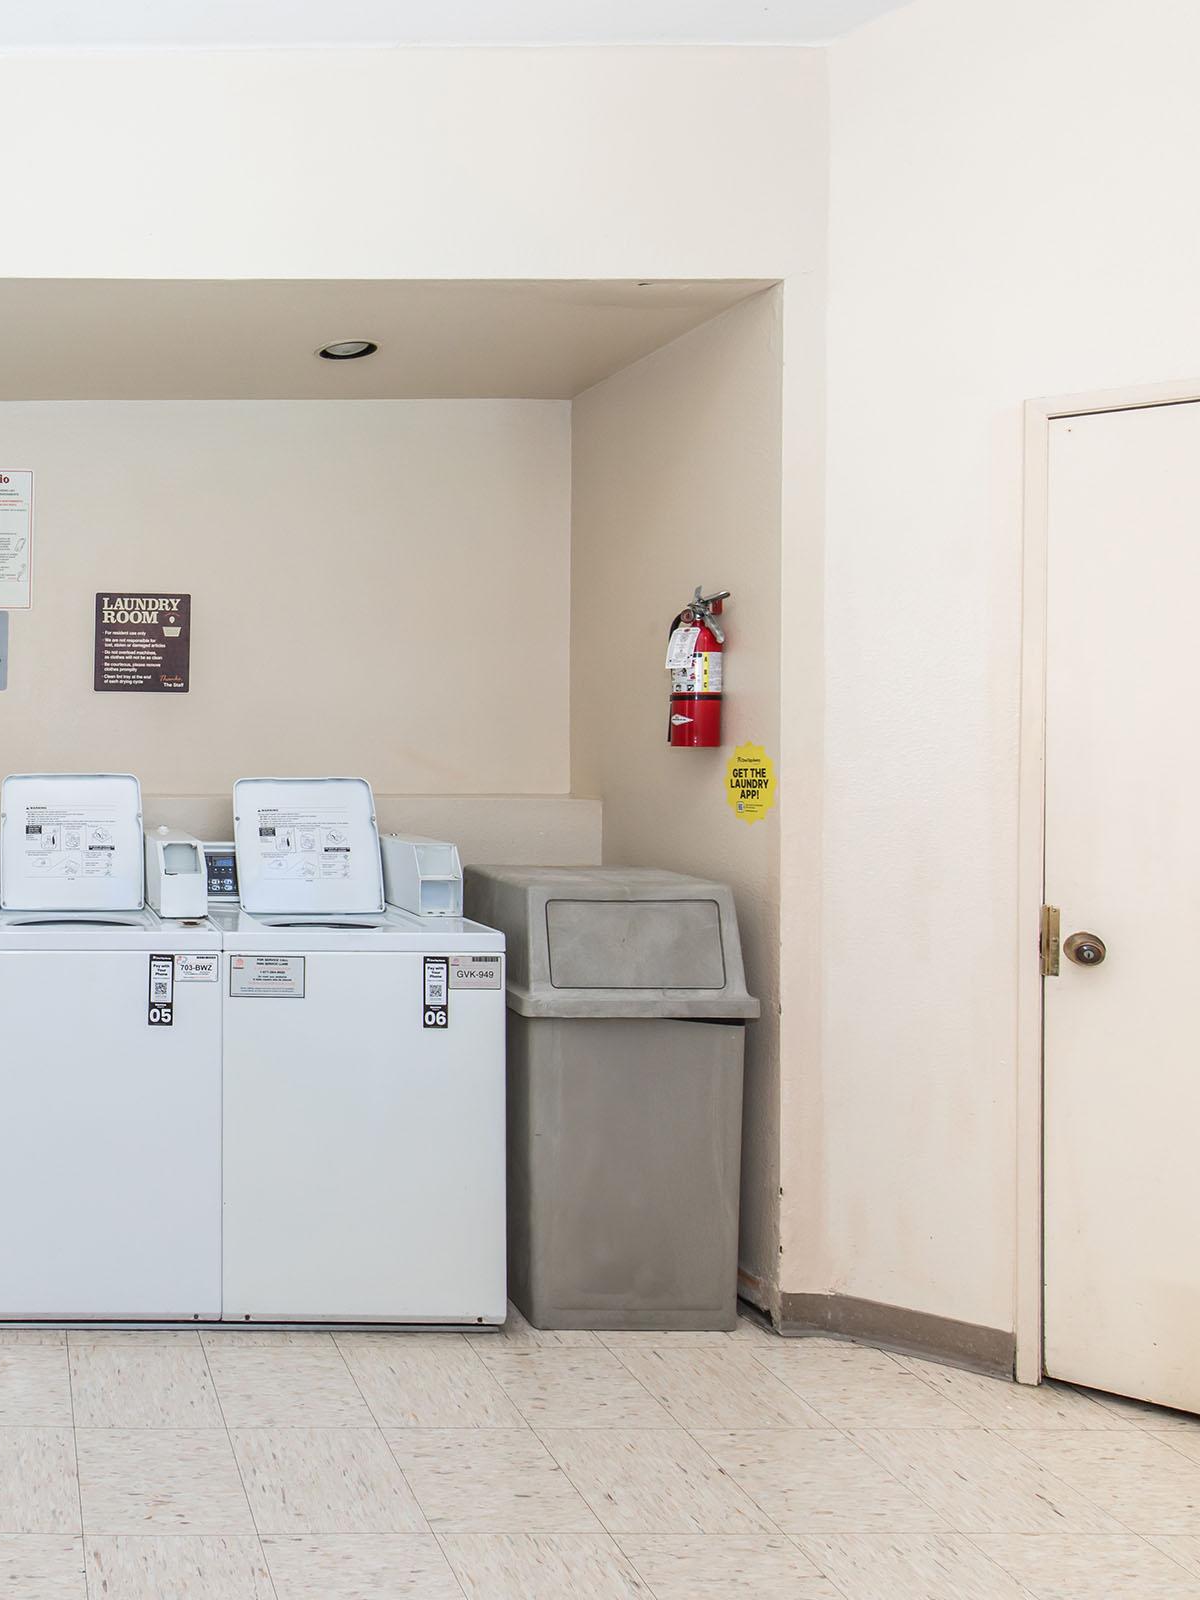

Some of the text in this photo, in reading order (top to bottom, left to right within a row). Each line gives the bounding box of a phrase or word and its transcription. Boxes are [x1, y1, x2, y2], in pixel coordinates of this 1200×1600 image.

[102, 598, 181, 611] LAUNDRY
[102, 611, 158, 624] ROOM
[733, 768, 766, 778] GET THE
[730, 779, 768, 788] LAUNDRY
[740, 790, 759, 799] APP!
[150, 1008, 171, 1022] 05
[425, 1011, 446, 1025] 06
